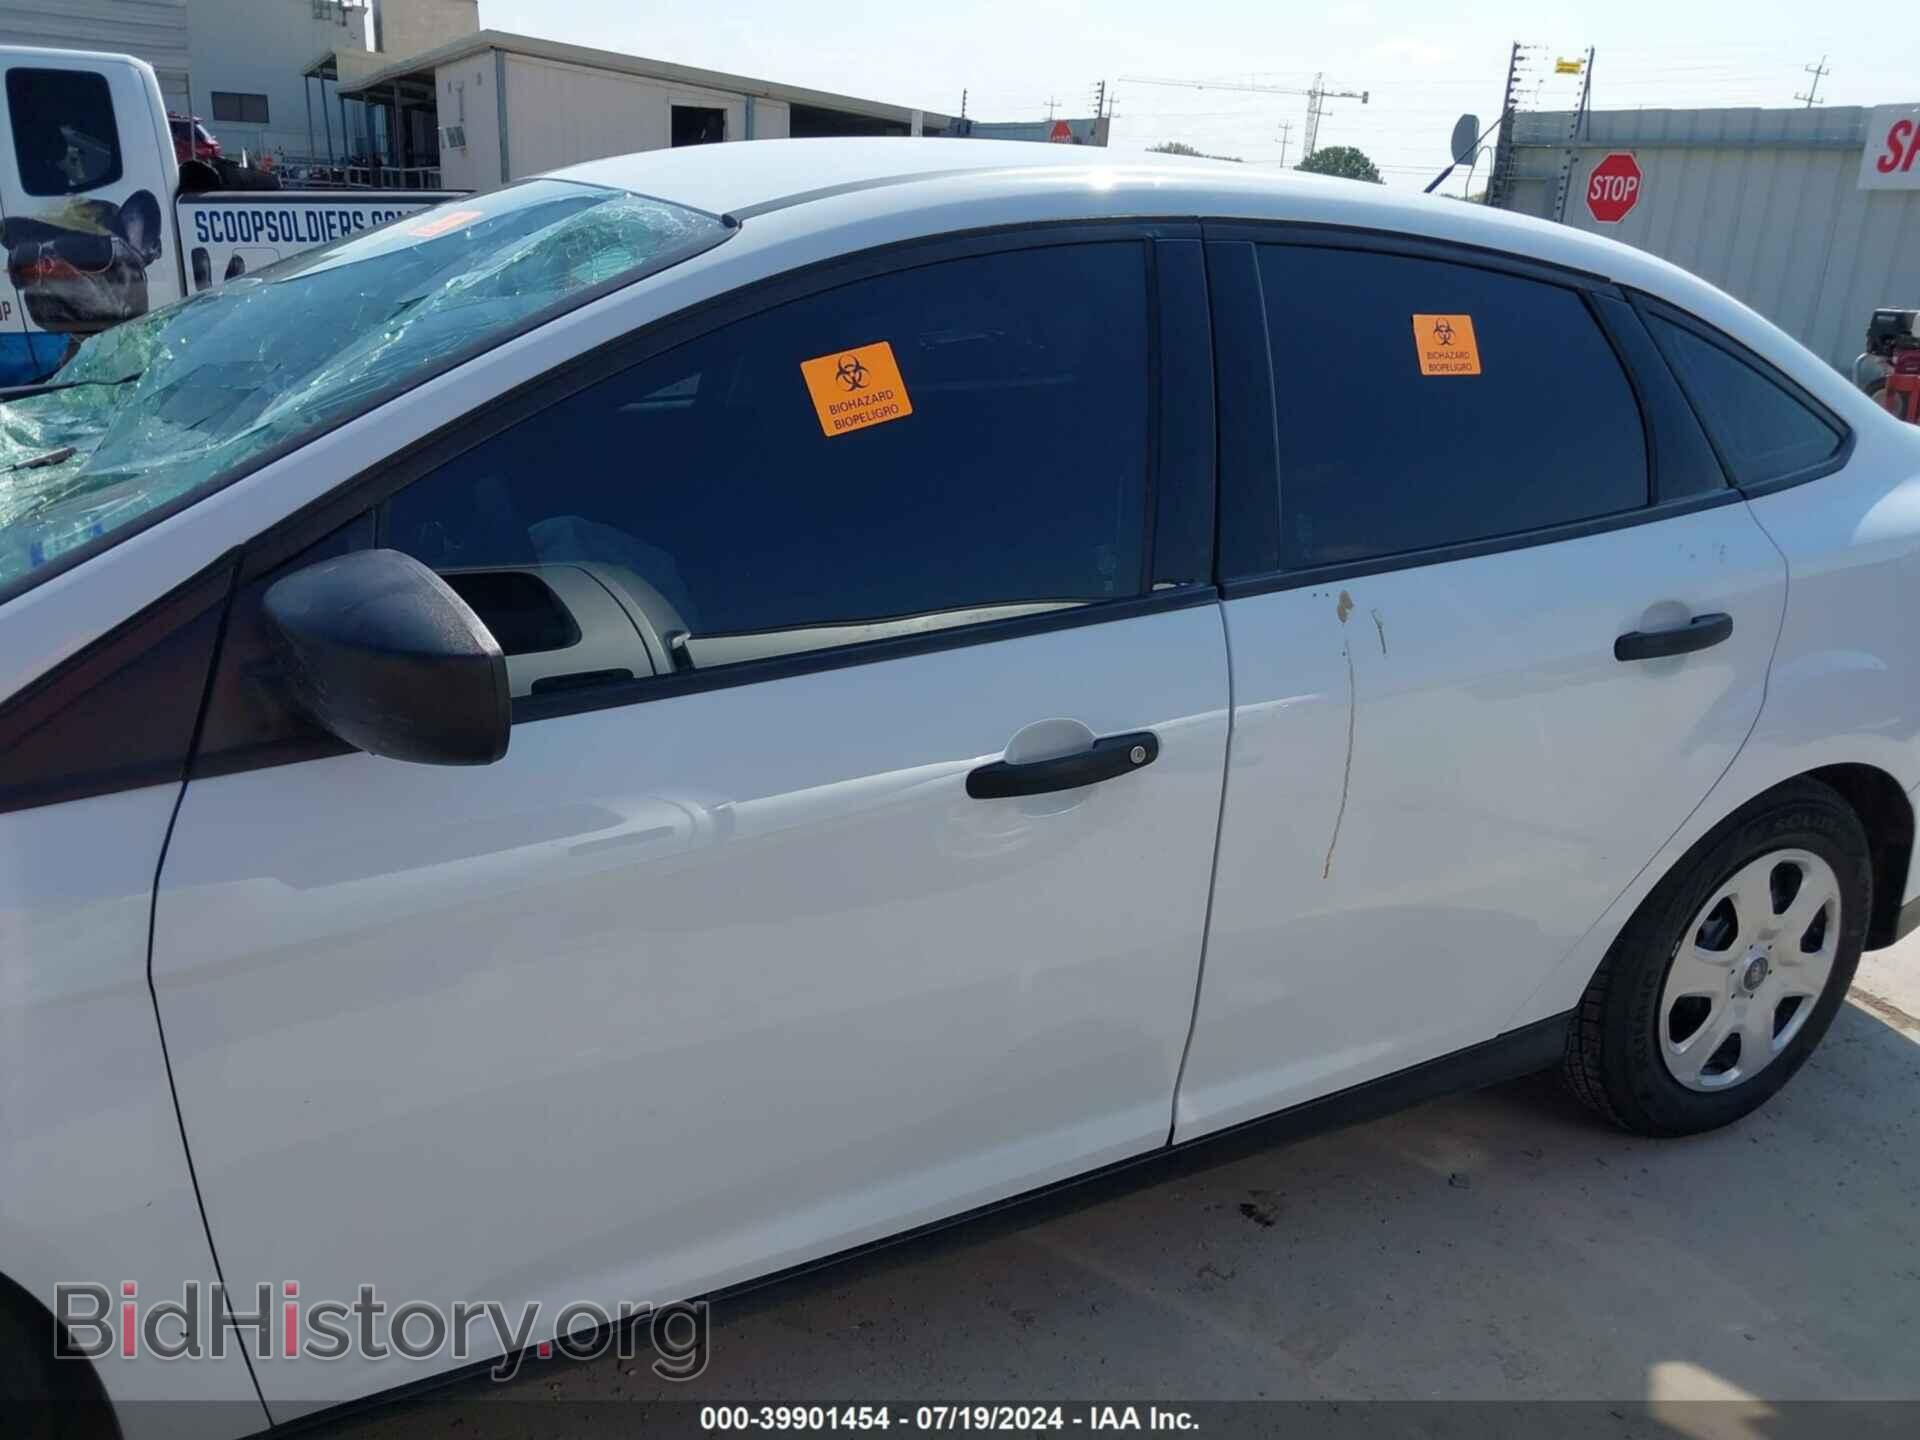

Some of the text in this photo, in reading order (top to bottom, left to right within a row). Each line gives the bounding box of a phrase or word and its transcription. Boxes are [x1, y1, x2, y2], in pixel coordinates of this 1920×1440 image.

[1590, 175, 1638, 202] STOP
[828, 390, 894, 415] BIOHAZARD
[833, 404, 900, 430] BIOPELIGRO
